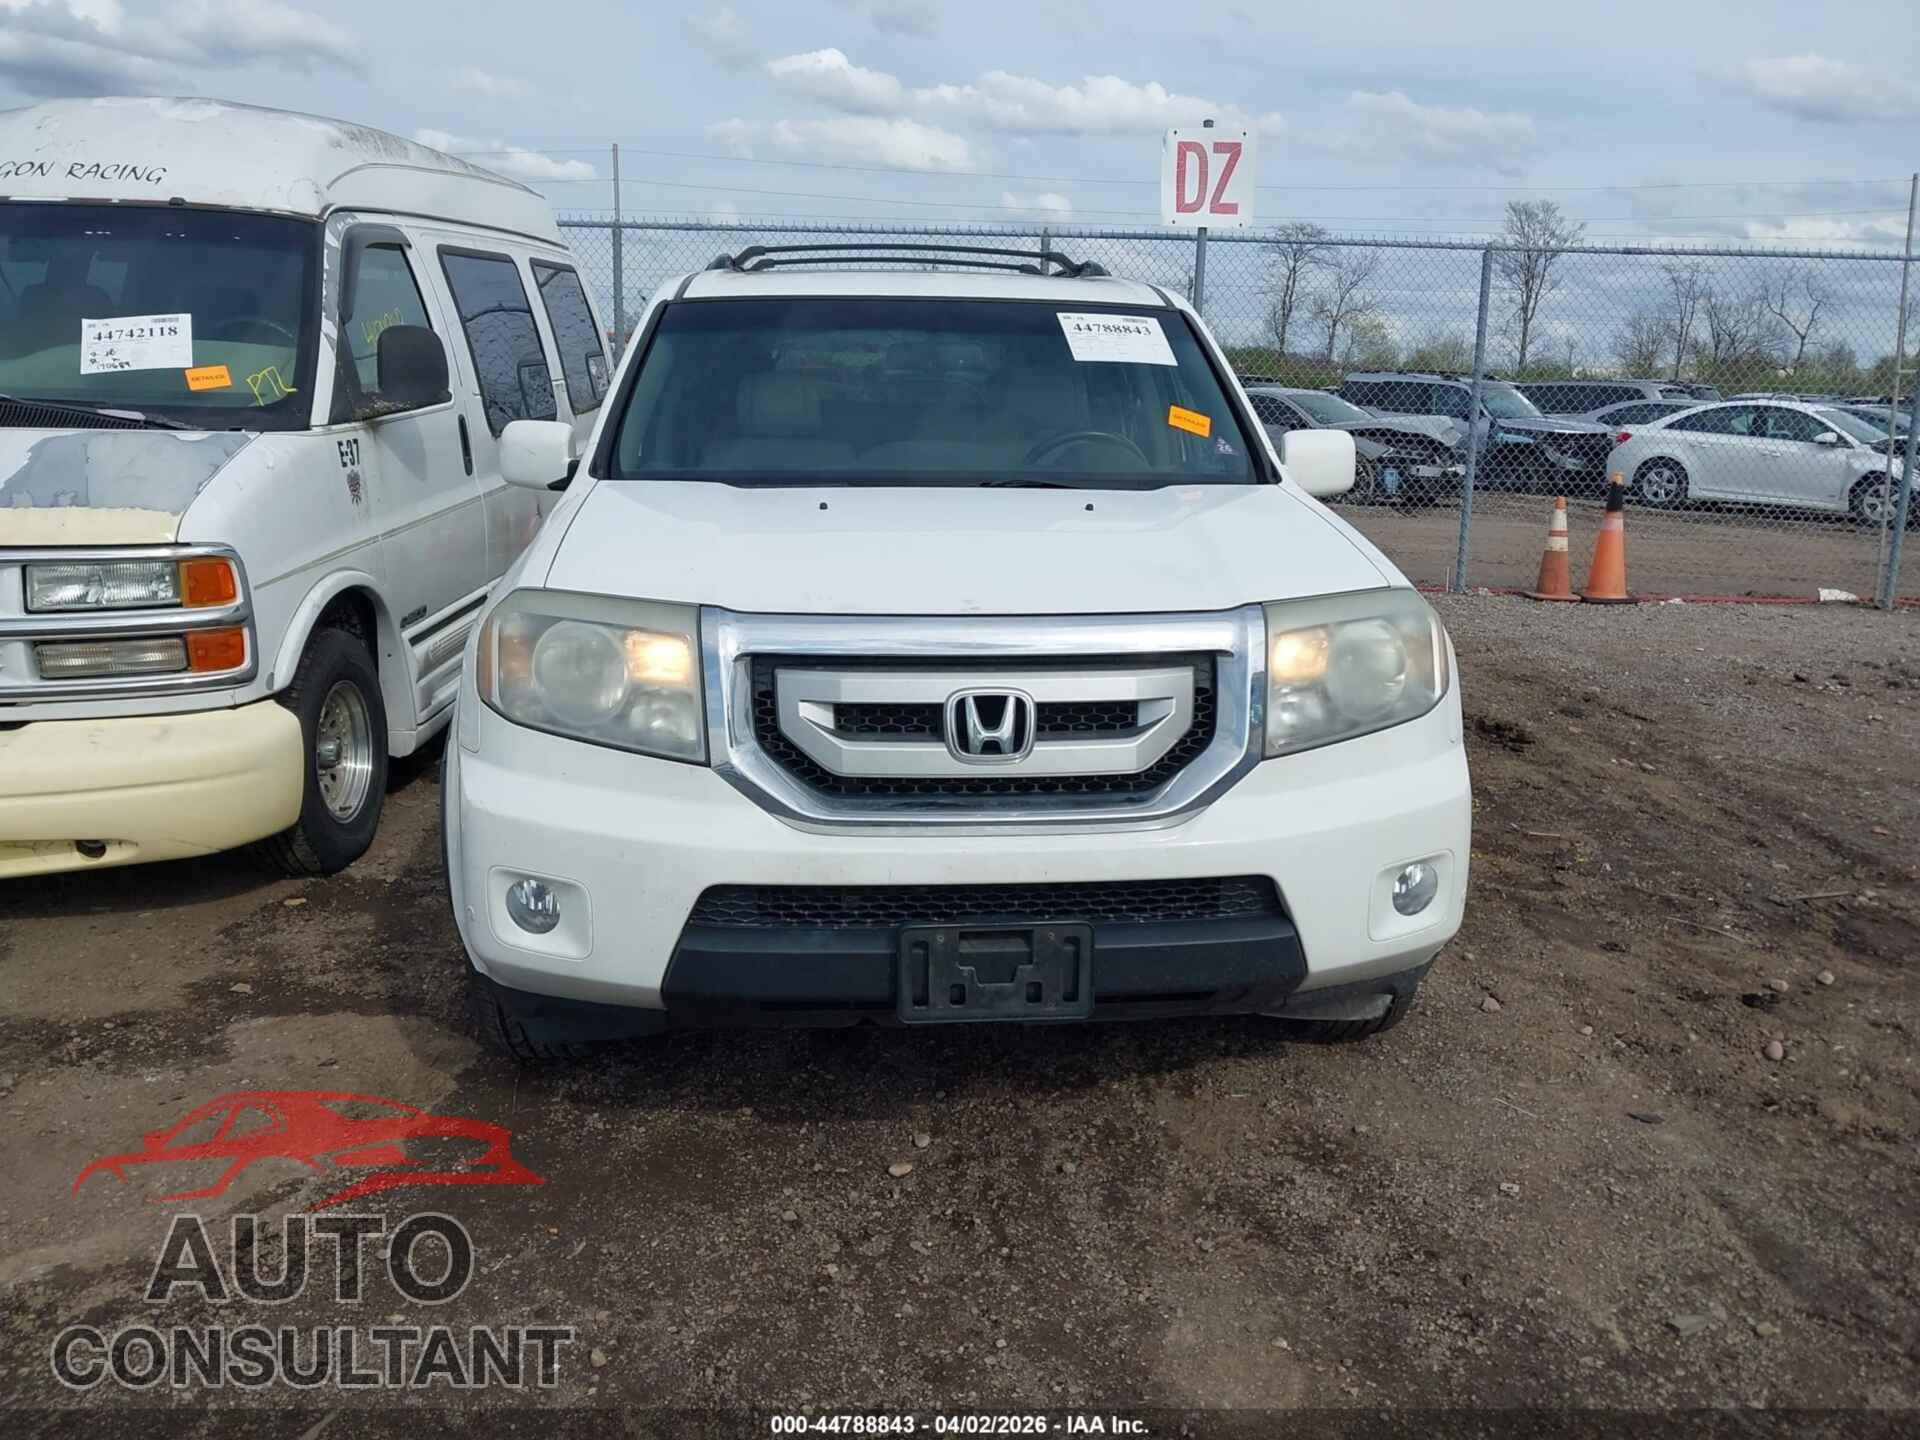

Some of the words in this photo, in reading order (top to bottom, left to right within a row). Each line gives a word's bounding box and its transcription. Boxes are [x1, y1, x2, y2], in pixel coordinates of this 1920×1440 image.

[65, 162, 167, 185] RACING
[1175, 140, 1243, 214] DZ
[93, 326, 178, 341] 44742118
[1073, 322, 1152, 336] 44788843
[337, 438, 360, 468] E-37
